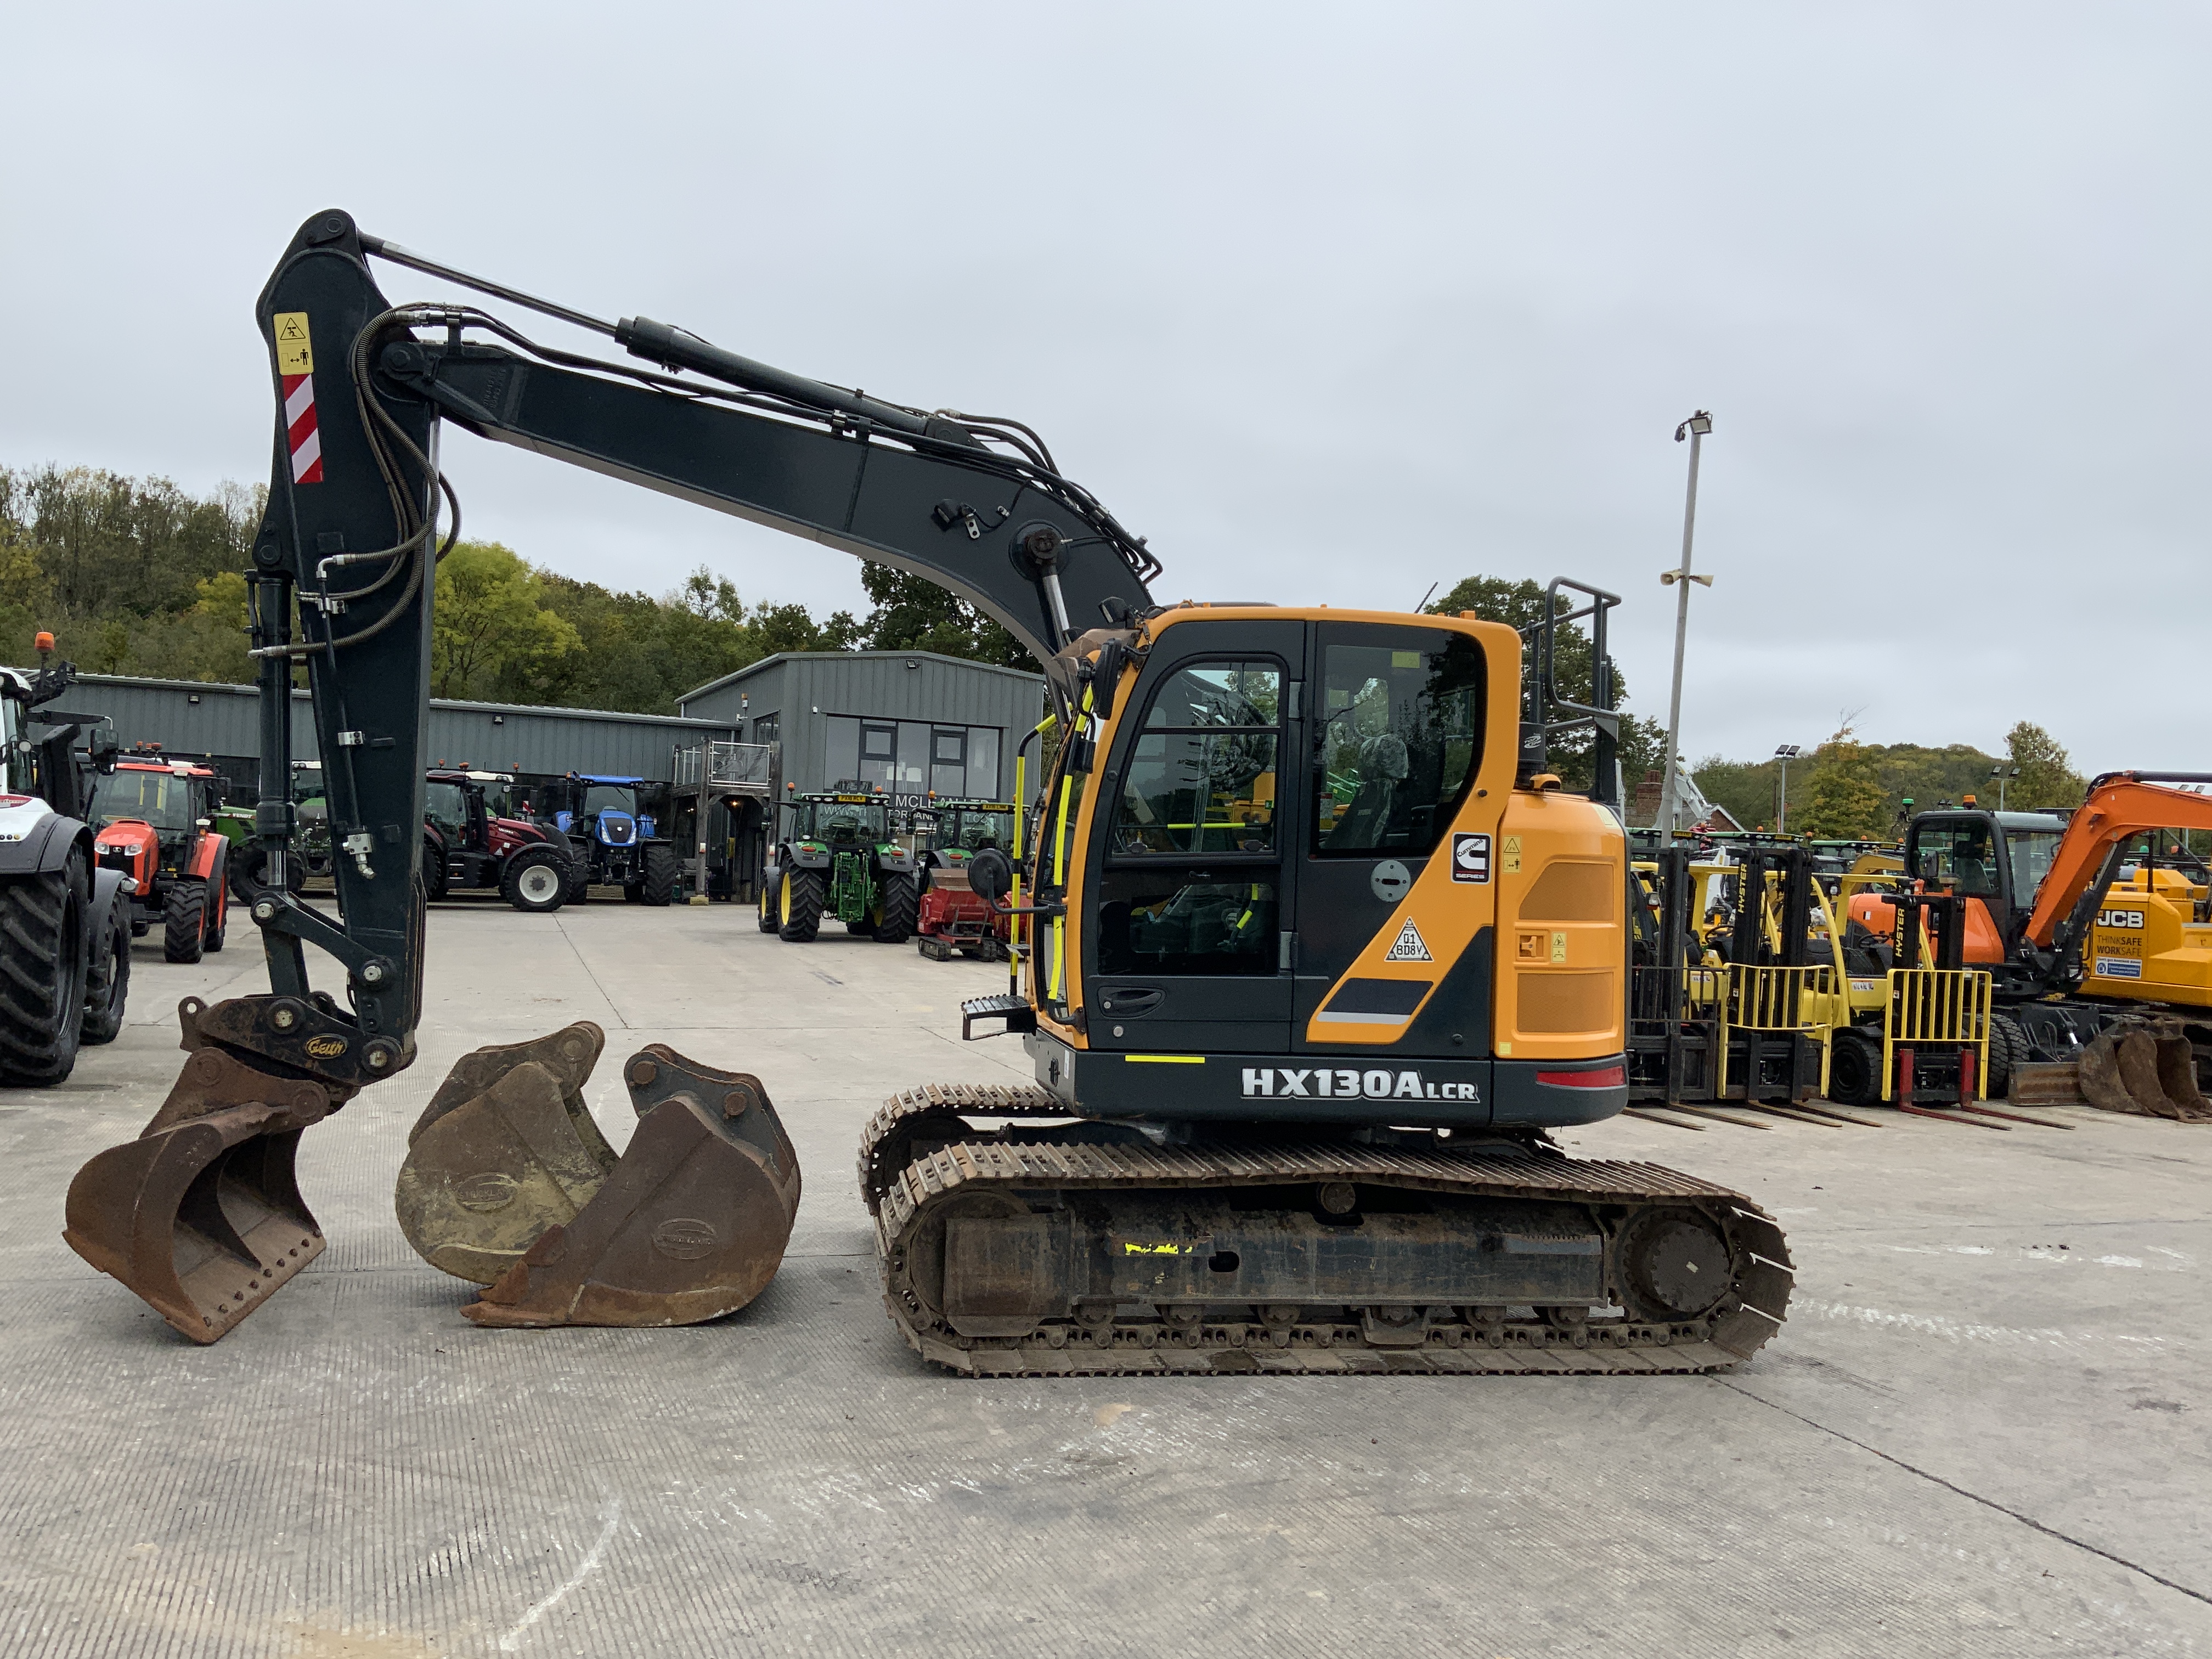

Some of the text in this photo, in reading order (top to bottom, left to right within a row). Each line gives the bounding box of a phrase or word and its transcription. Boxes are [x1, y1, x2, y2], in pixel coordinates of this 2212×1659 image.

[896, 795, 958, 809] MCLEA
[1457, 839, 1483, 857] Cummins
[1738, 863, 1747, 913] HYSTER
[2097, 910, 2143, 928] JCB
[1895, 908, 1905, 957] HYSTER
